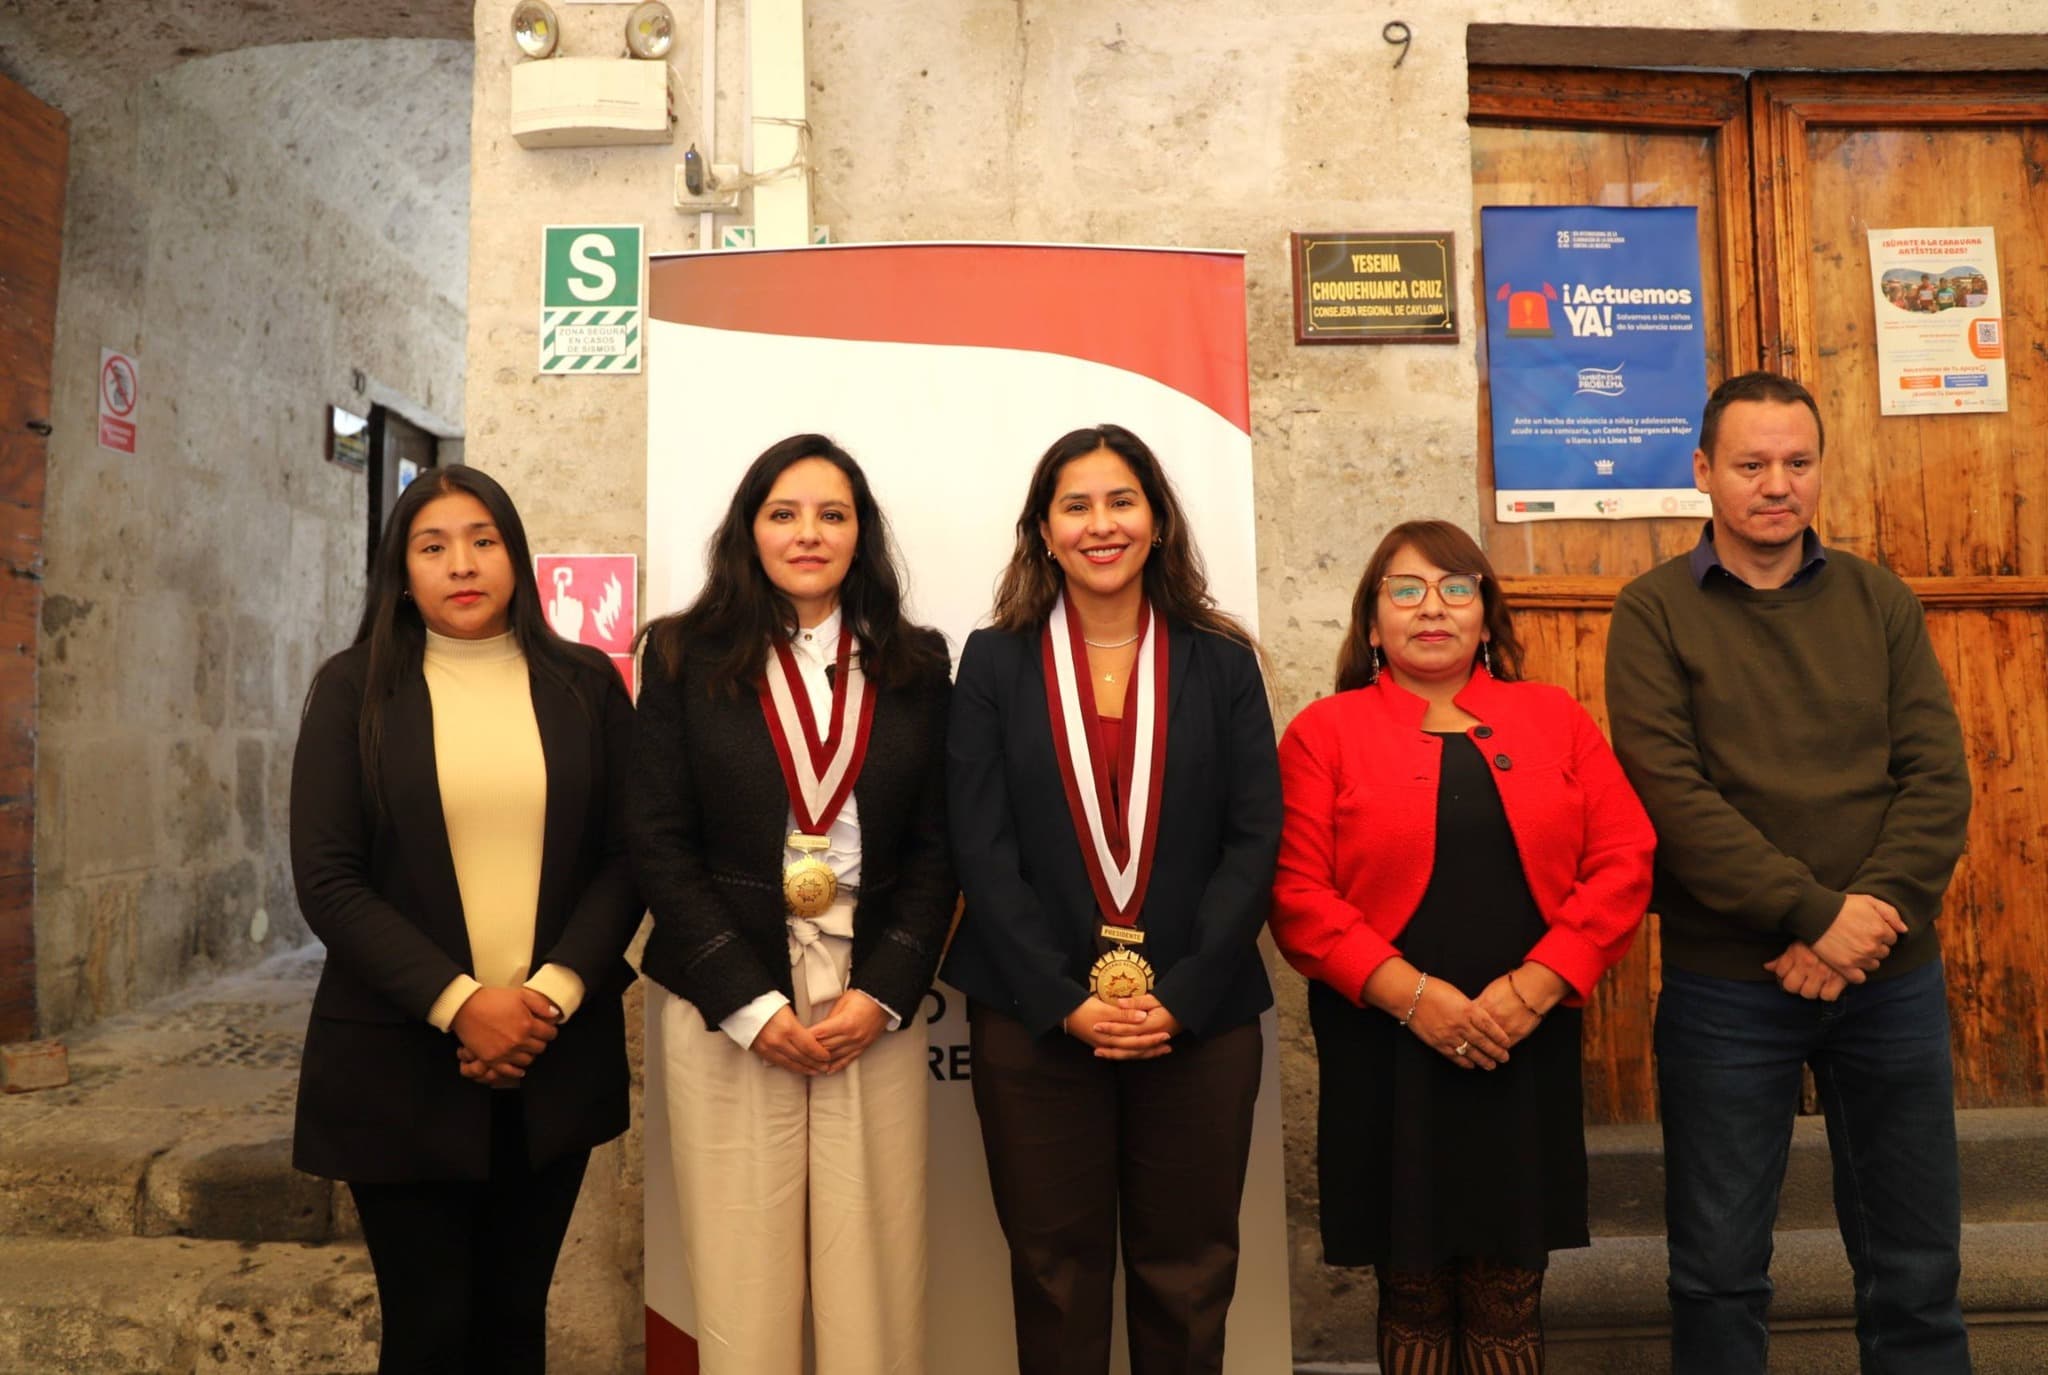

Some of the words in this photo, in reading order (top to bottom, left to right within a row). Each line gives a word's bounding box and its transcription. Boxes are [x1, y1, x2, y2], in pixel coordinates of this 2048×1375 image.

[1382, 20, 1412, 70] 9
[1939, 238, 1983, 246] CARAVANA
[567, 233, 617, 302] S
[1351, 254, 1401, 273] YESENIA
[1312, 281, 1409, 301] CHOQUEHUANCA
[1411, 280, 1443, 299] CRUZ
[1563, 284, 1692, 304] ¡Actuemos
[1313, 306, 1357, 317] CONSEJERA
[1359, 305, 1393, 316] REGIONAL
[1395, 304, 1405, 316] DE
[1406, 303, 1444, 316] CAYLLOMA
[1563, 306, 1613, 337] YA!
[1616, 323, 1626, 331] de
[1636, 323, 1668, 331] violencia
[1669, 323, 1693, 331] sexual
[559, 328, 585, 336] ZONA
[587, 328, 626, 336] SEGURA
[583, 336, 615, 344] CASOS
[567, 345, 578, 353] DE
[582, 345, 616, 353] SISMOS
[1514, 417, 1532, 425] Ante
[1565, 417, 1575, 425] de
[1576, 417, 1607, 425] violencia
[1603, 426, 1627, 434] Centro
[1628, 426, 1670, 436] Emergencia
[1671, 426, 1693, 436] Mujer
[1104, 928, 1143, 942] PRESIDENTE
